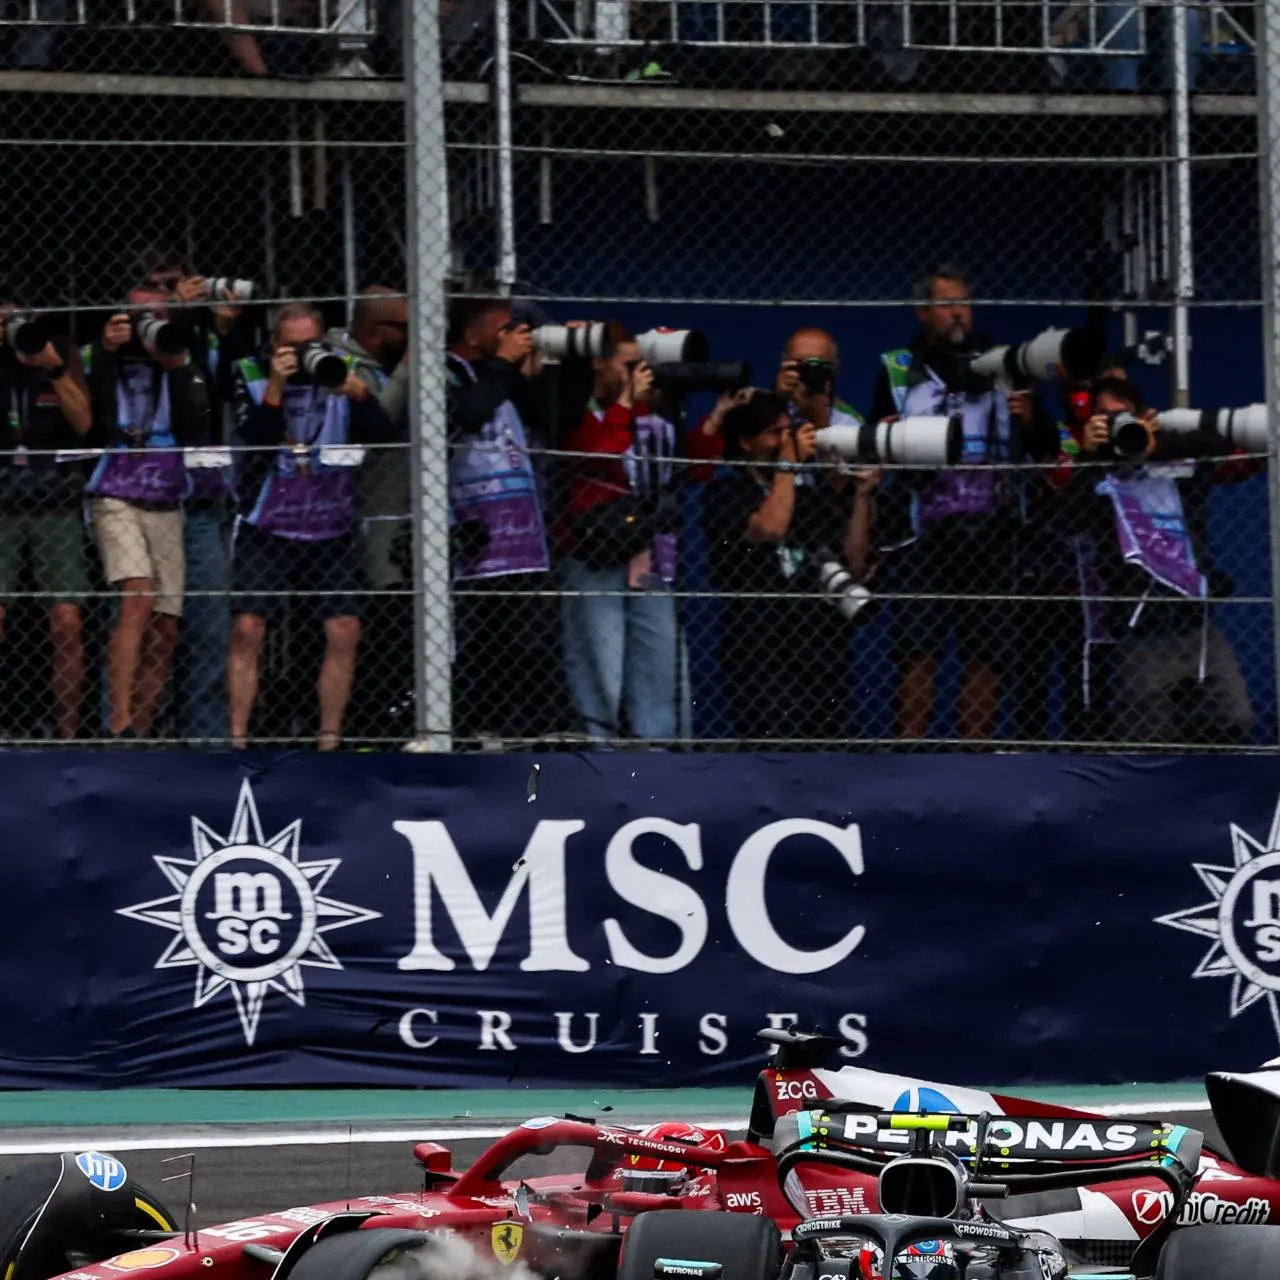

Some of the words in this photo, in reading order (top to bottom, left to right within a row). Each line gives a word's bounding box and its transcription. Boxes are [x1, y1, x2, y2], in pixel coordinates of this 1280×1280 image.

[393, 817, 866, 974] MSC
[775, 1080, 817, 1100] ZCG
[627, 1137, 687, 1154] TECHNOLOGY
[843, 1114, 1138, 1152] PERONAS
[87, 1151, 121, 1191] hp
[726, 1192, 762, 1208] aws
[805, 1187, 871, 1218] IBM
[663, 1265, 704, 1277] PETRONAS
